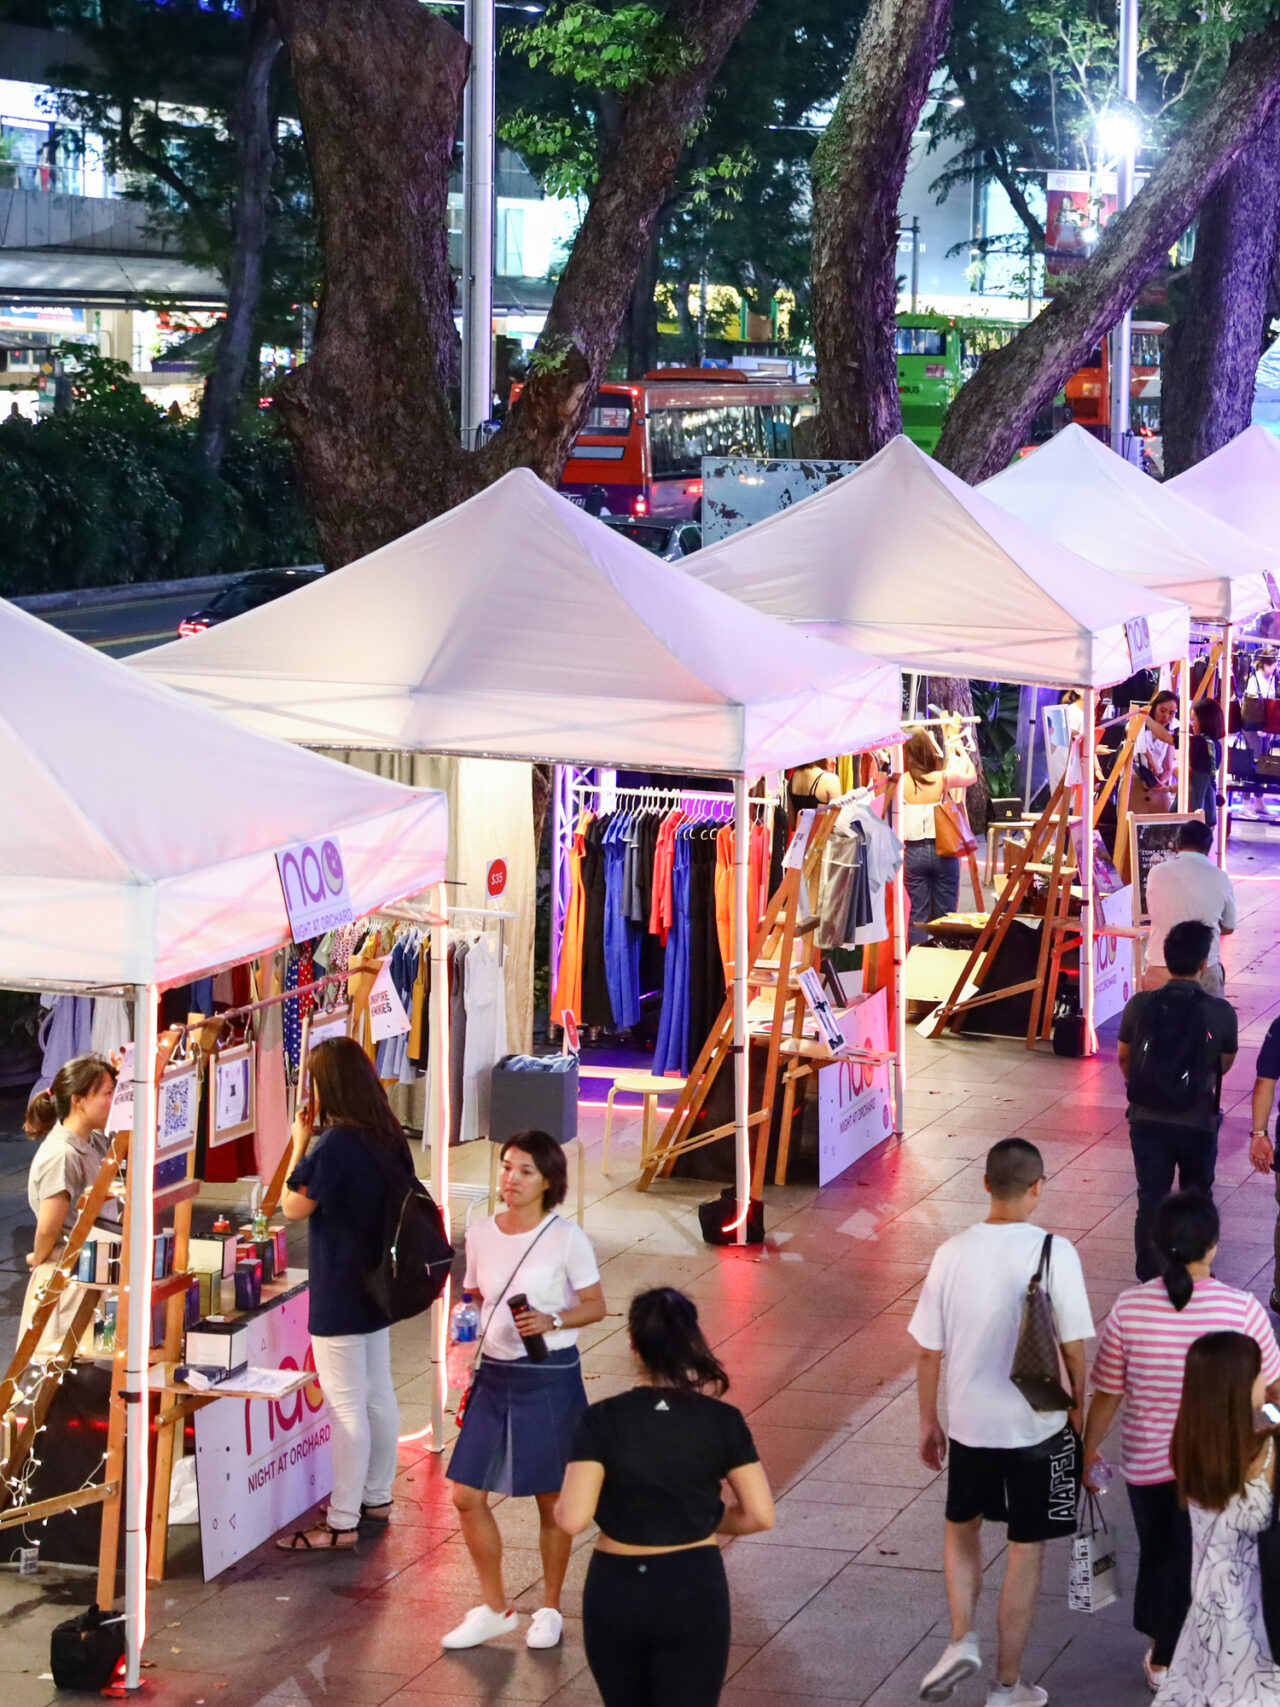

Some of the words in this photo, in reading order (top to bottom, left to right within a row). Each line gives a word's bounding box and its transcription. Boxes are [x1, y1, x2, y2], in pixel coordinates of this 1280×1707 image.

[490, 872, 504, 886] $35
[247, 1460, 276, 1494] NIGHT
[277, 1451, 289, 1473] AT
[289, 1424, 332, 1466] ORCHARD
[1048, 1452, 1076, 1521] AAPE
